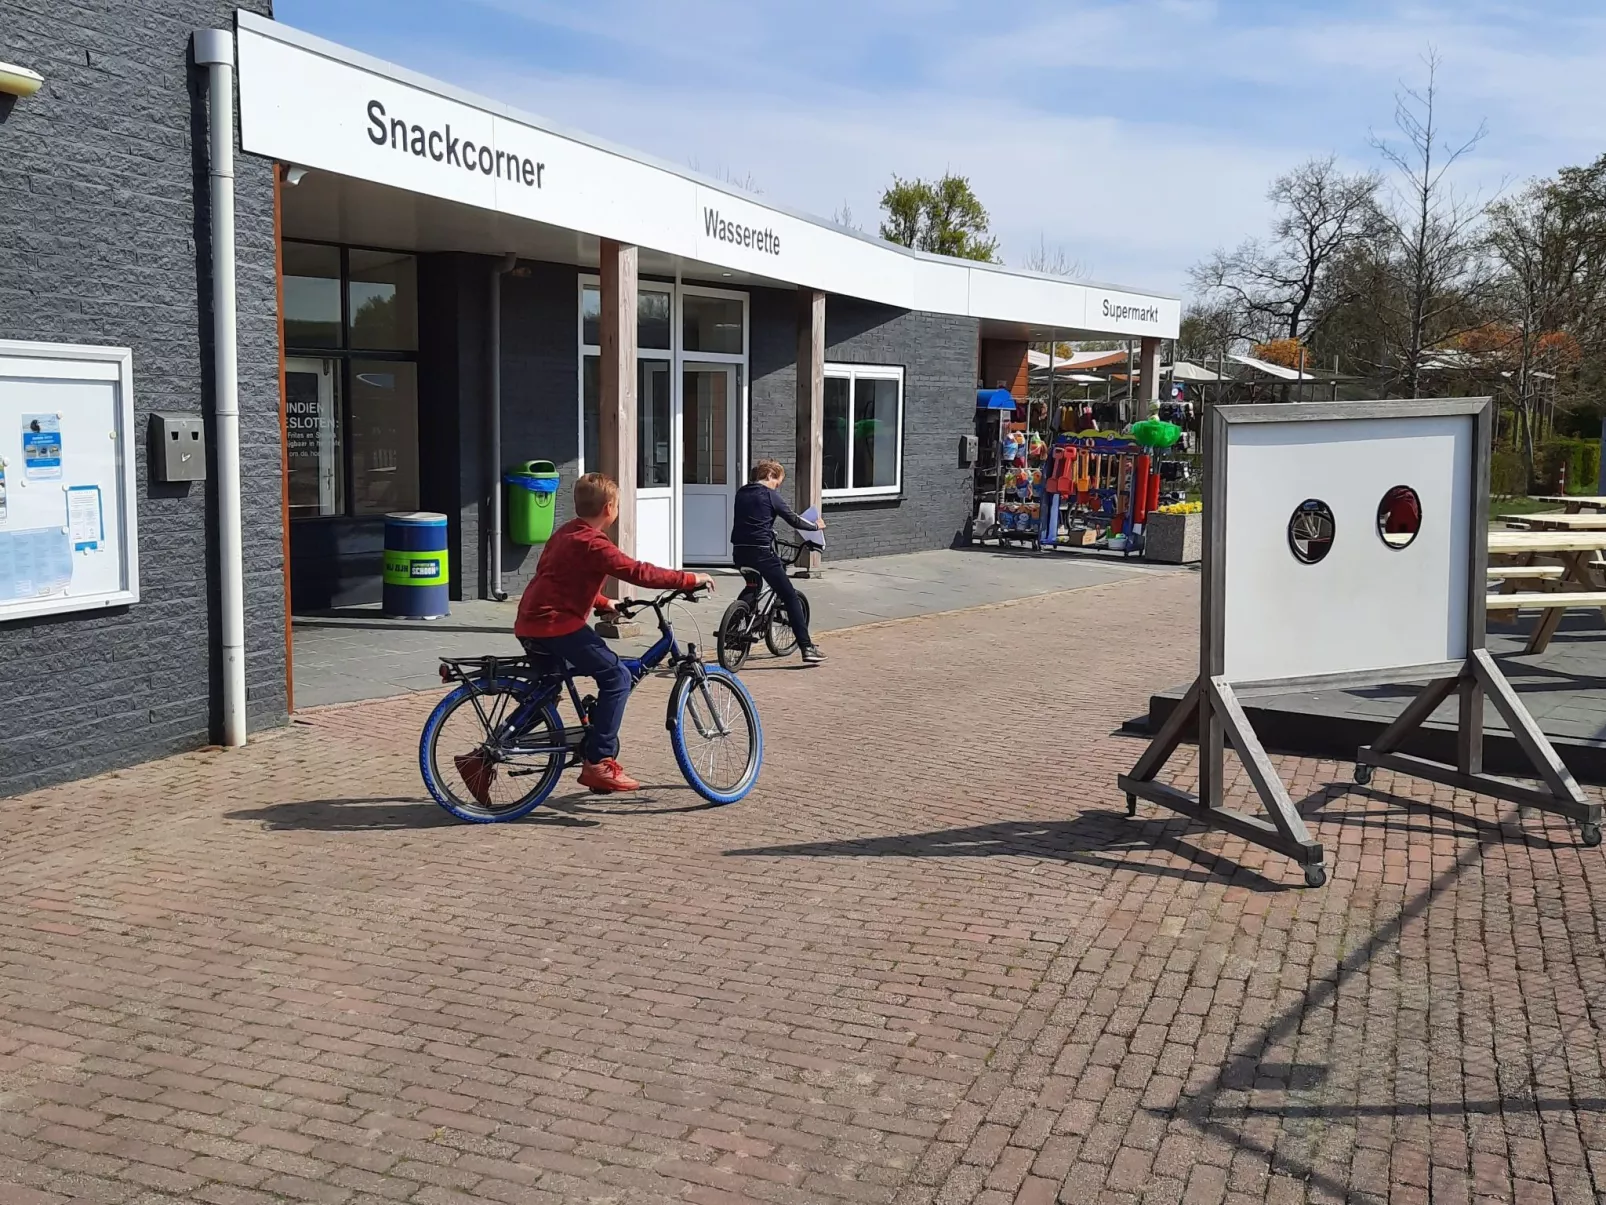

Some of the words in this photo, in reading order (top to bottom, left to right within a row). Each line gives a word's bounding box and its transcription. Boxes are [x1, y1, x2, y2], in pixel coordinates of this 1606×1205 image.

[367, 99, 545, 189] Snackcorner
[704, 206, 780, 256] Wasserette
[1102, 298, 1159, 323] Supermarkt
[286, 402, 324, 413] INDIEN
